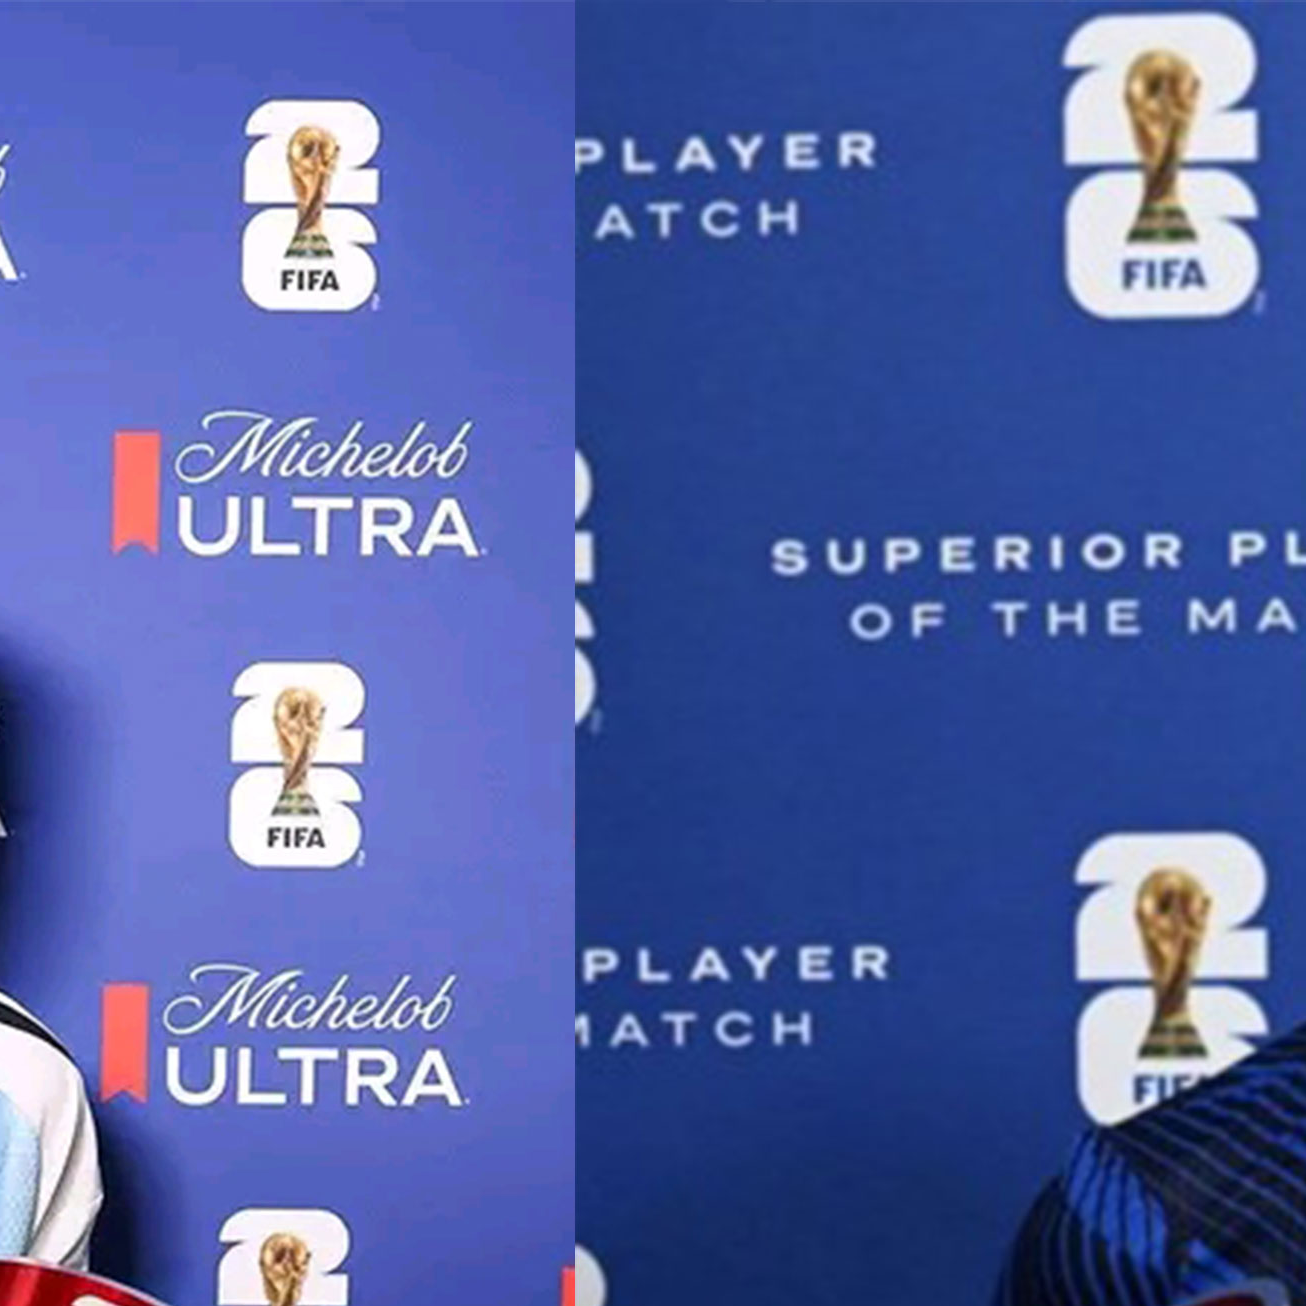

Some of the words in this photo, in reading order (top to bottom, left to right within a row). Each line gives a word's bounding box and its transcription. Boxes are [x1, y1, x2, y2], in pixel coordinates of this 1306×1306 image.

[575, 131, 876, 174] PLAYER
[595, 200, 798, 239] ATCH
[280, 269, 340, 291] FIFA
[1122, 258, 1207, 291] FIFA
[174, 410, 472, 484] Michelob
[178, 495, 479, 557] ULTRA
[772, 533, 1182, 576] SUPERIOR
[849, 602, 945, 640] OF
[991, 599, 1141, 637] THE
[267, 826, 326, 849] FIFA
[583, 945, 889, 983] PLAYER
[162, 963, 456, 1035] Michelob
[166, 1046, 462, 1106] ULTRA
